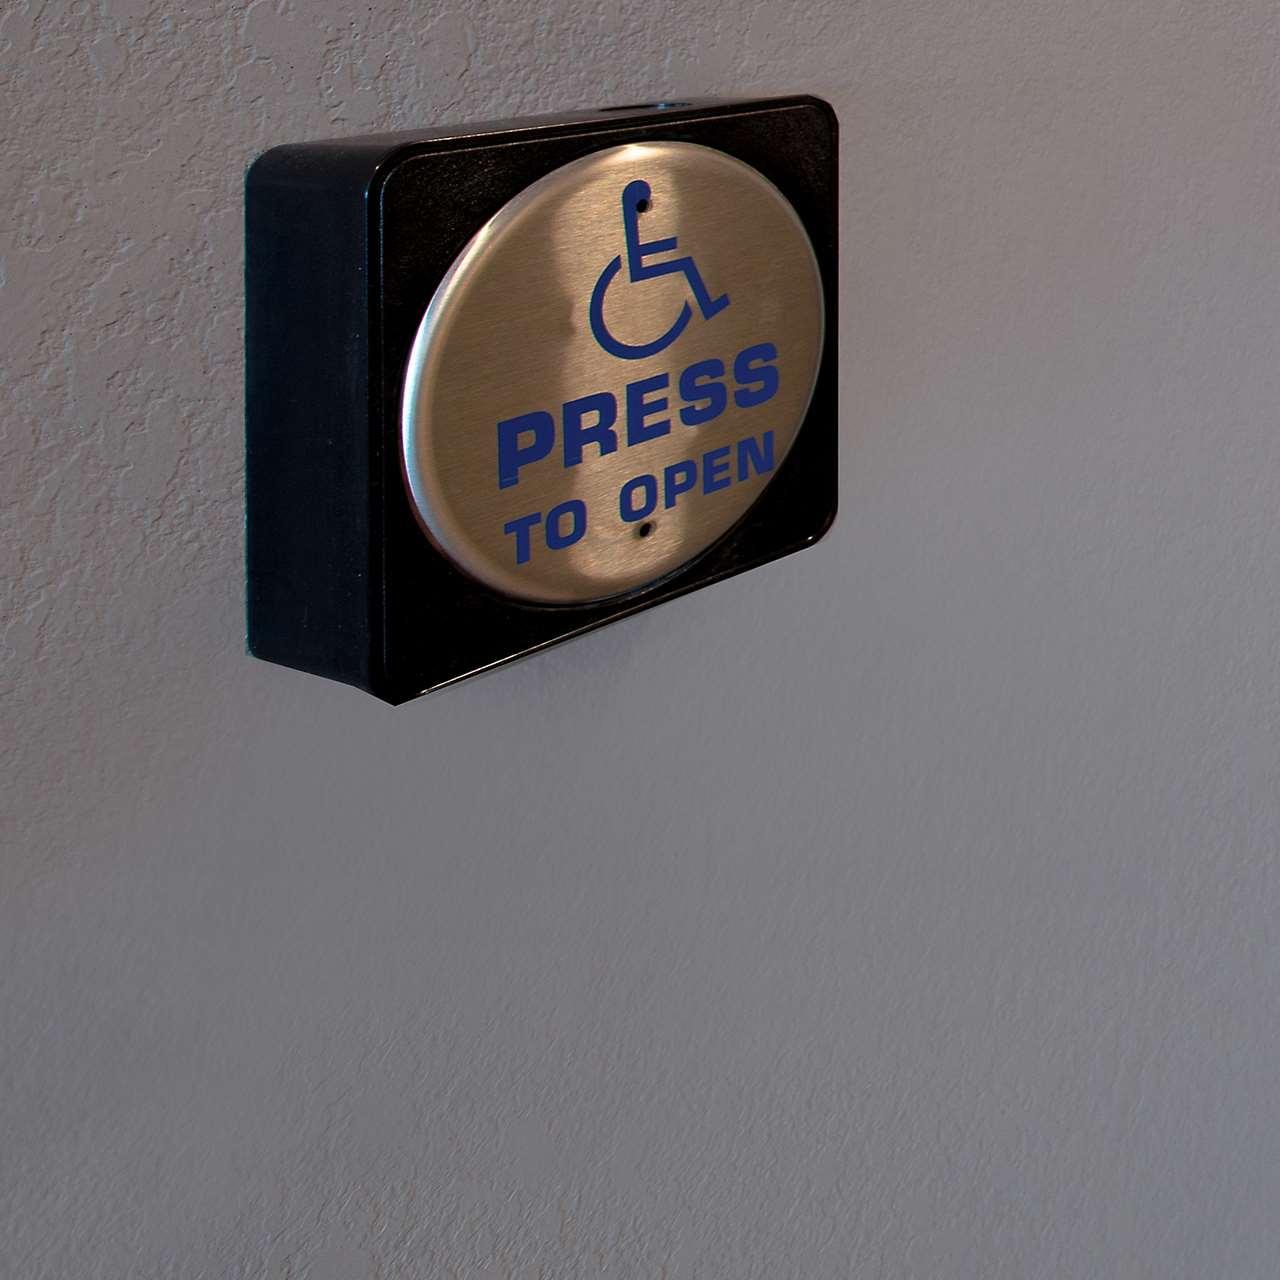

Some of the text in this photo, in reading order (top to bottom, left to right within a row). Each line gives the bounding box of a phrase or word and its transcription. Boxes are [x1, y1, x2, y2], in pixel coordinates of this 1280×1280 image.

[496, 342, 780, 490] PRESS
[504, 430, 776, 565] TO OPEN
